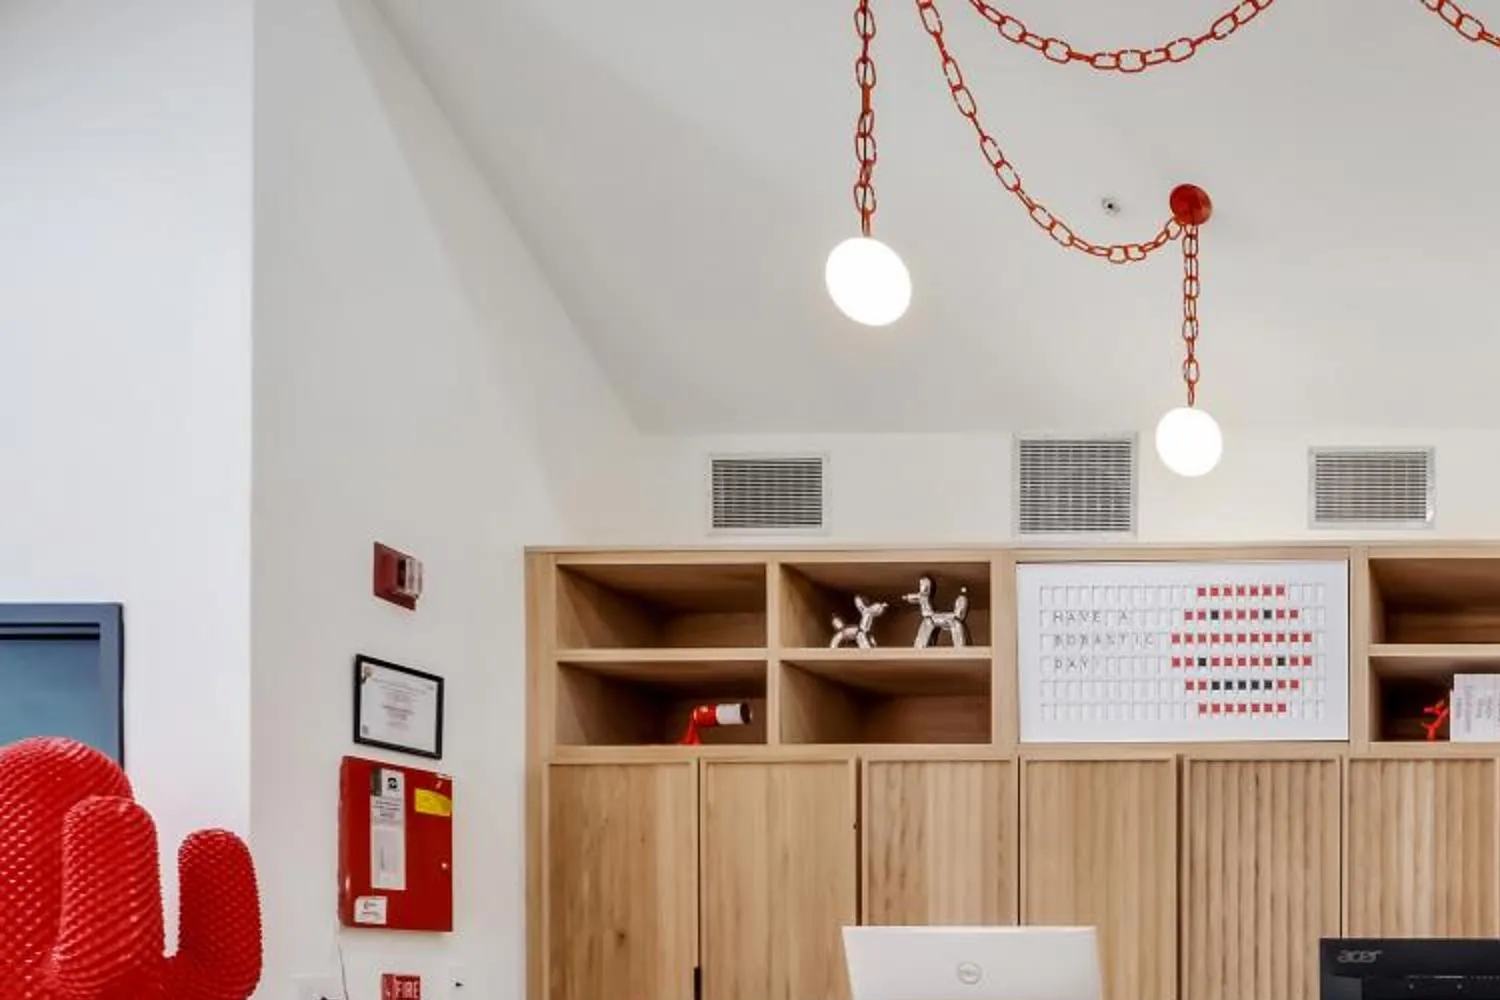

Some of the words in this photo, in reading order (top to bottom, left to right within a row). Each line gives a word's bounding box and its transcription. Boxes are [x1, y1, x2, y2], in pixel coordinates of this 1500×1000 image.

[1053, 610, 1100, 622] HAVE
[1055, 658, 1088, 669] DAY
[1337, 950, 1382, 963] acer
[395, 981, 419, 998] FIRE
